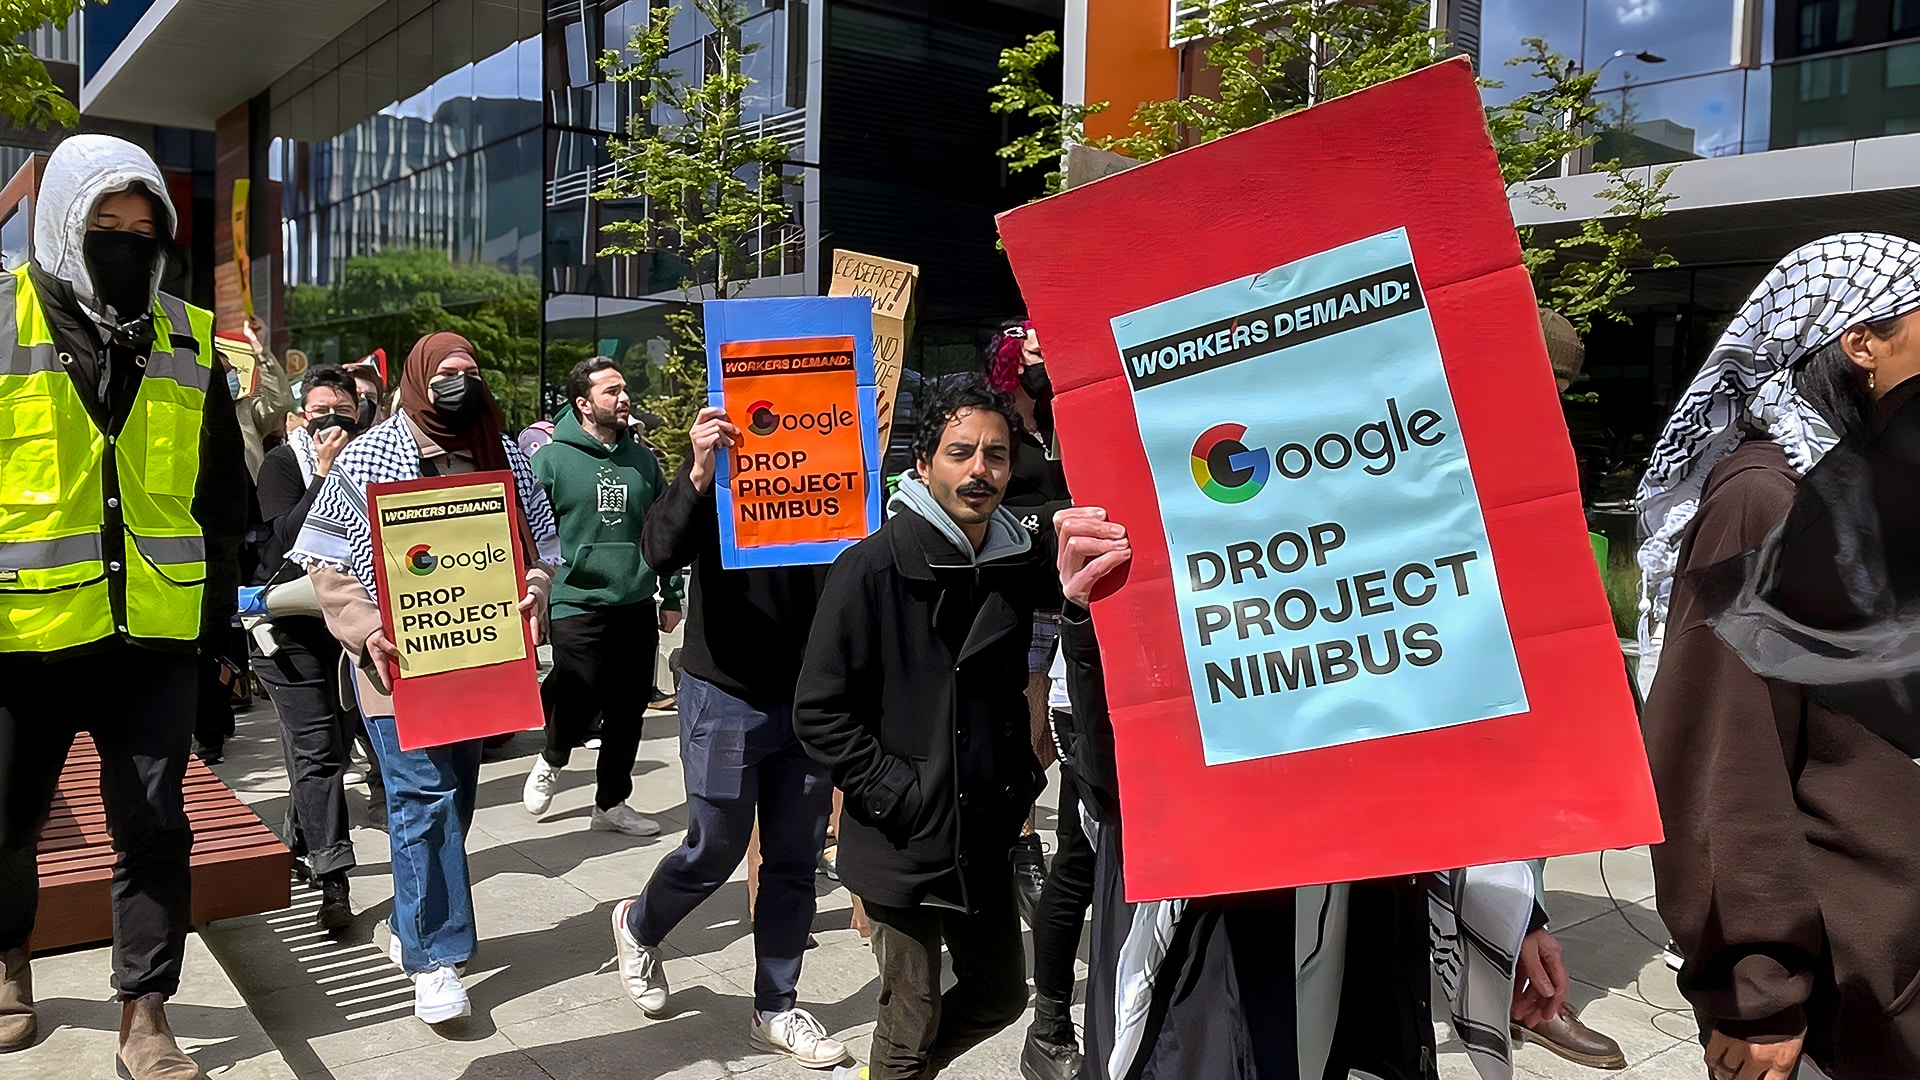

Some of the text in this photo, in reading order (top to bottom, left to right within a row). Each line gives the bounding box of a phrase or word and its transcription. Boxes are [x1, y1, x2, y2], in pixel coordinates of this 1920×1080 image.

[1131, 280, 1412, 379] WORKERS DEMAND:
[726, 355, 851, 373] WORKERS DEMAND:
[745, 400, 854, 436] Google
[736, 450, 807, 473] DROP
[1190, 397, 1447, 505] Google
[738, 471, 858, 498] PROJECT
[385, 500, 502, 523] WORKERS DEMAND:
[740, 497, 840, 522] NIMBUS
[404, 542, 507, 577] Google
[1186, 521, 1347, 592] DROP
[399, 586, 466, 610] DROP
[1194, 551, 1479, 647] PROJECT
[402, 600, 513, 632] PROJECT
[405, 625, 498, 655] NIMBUS
[1204, 621, 1443, 705] NIMBUS
